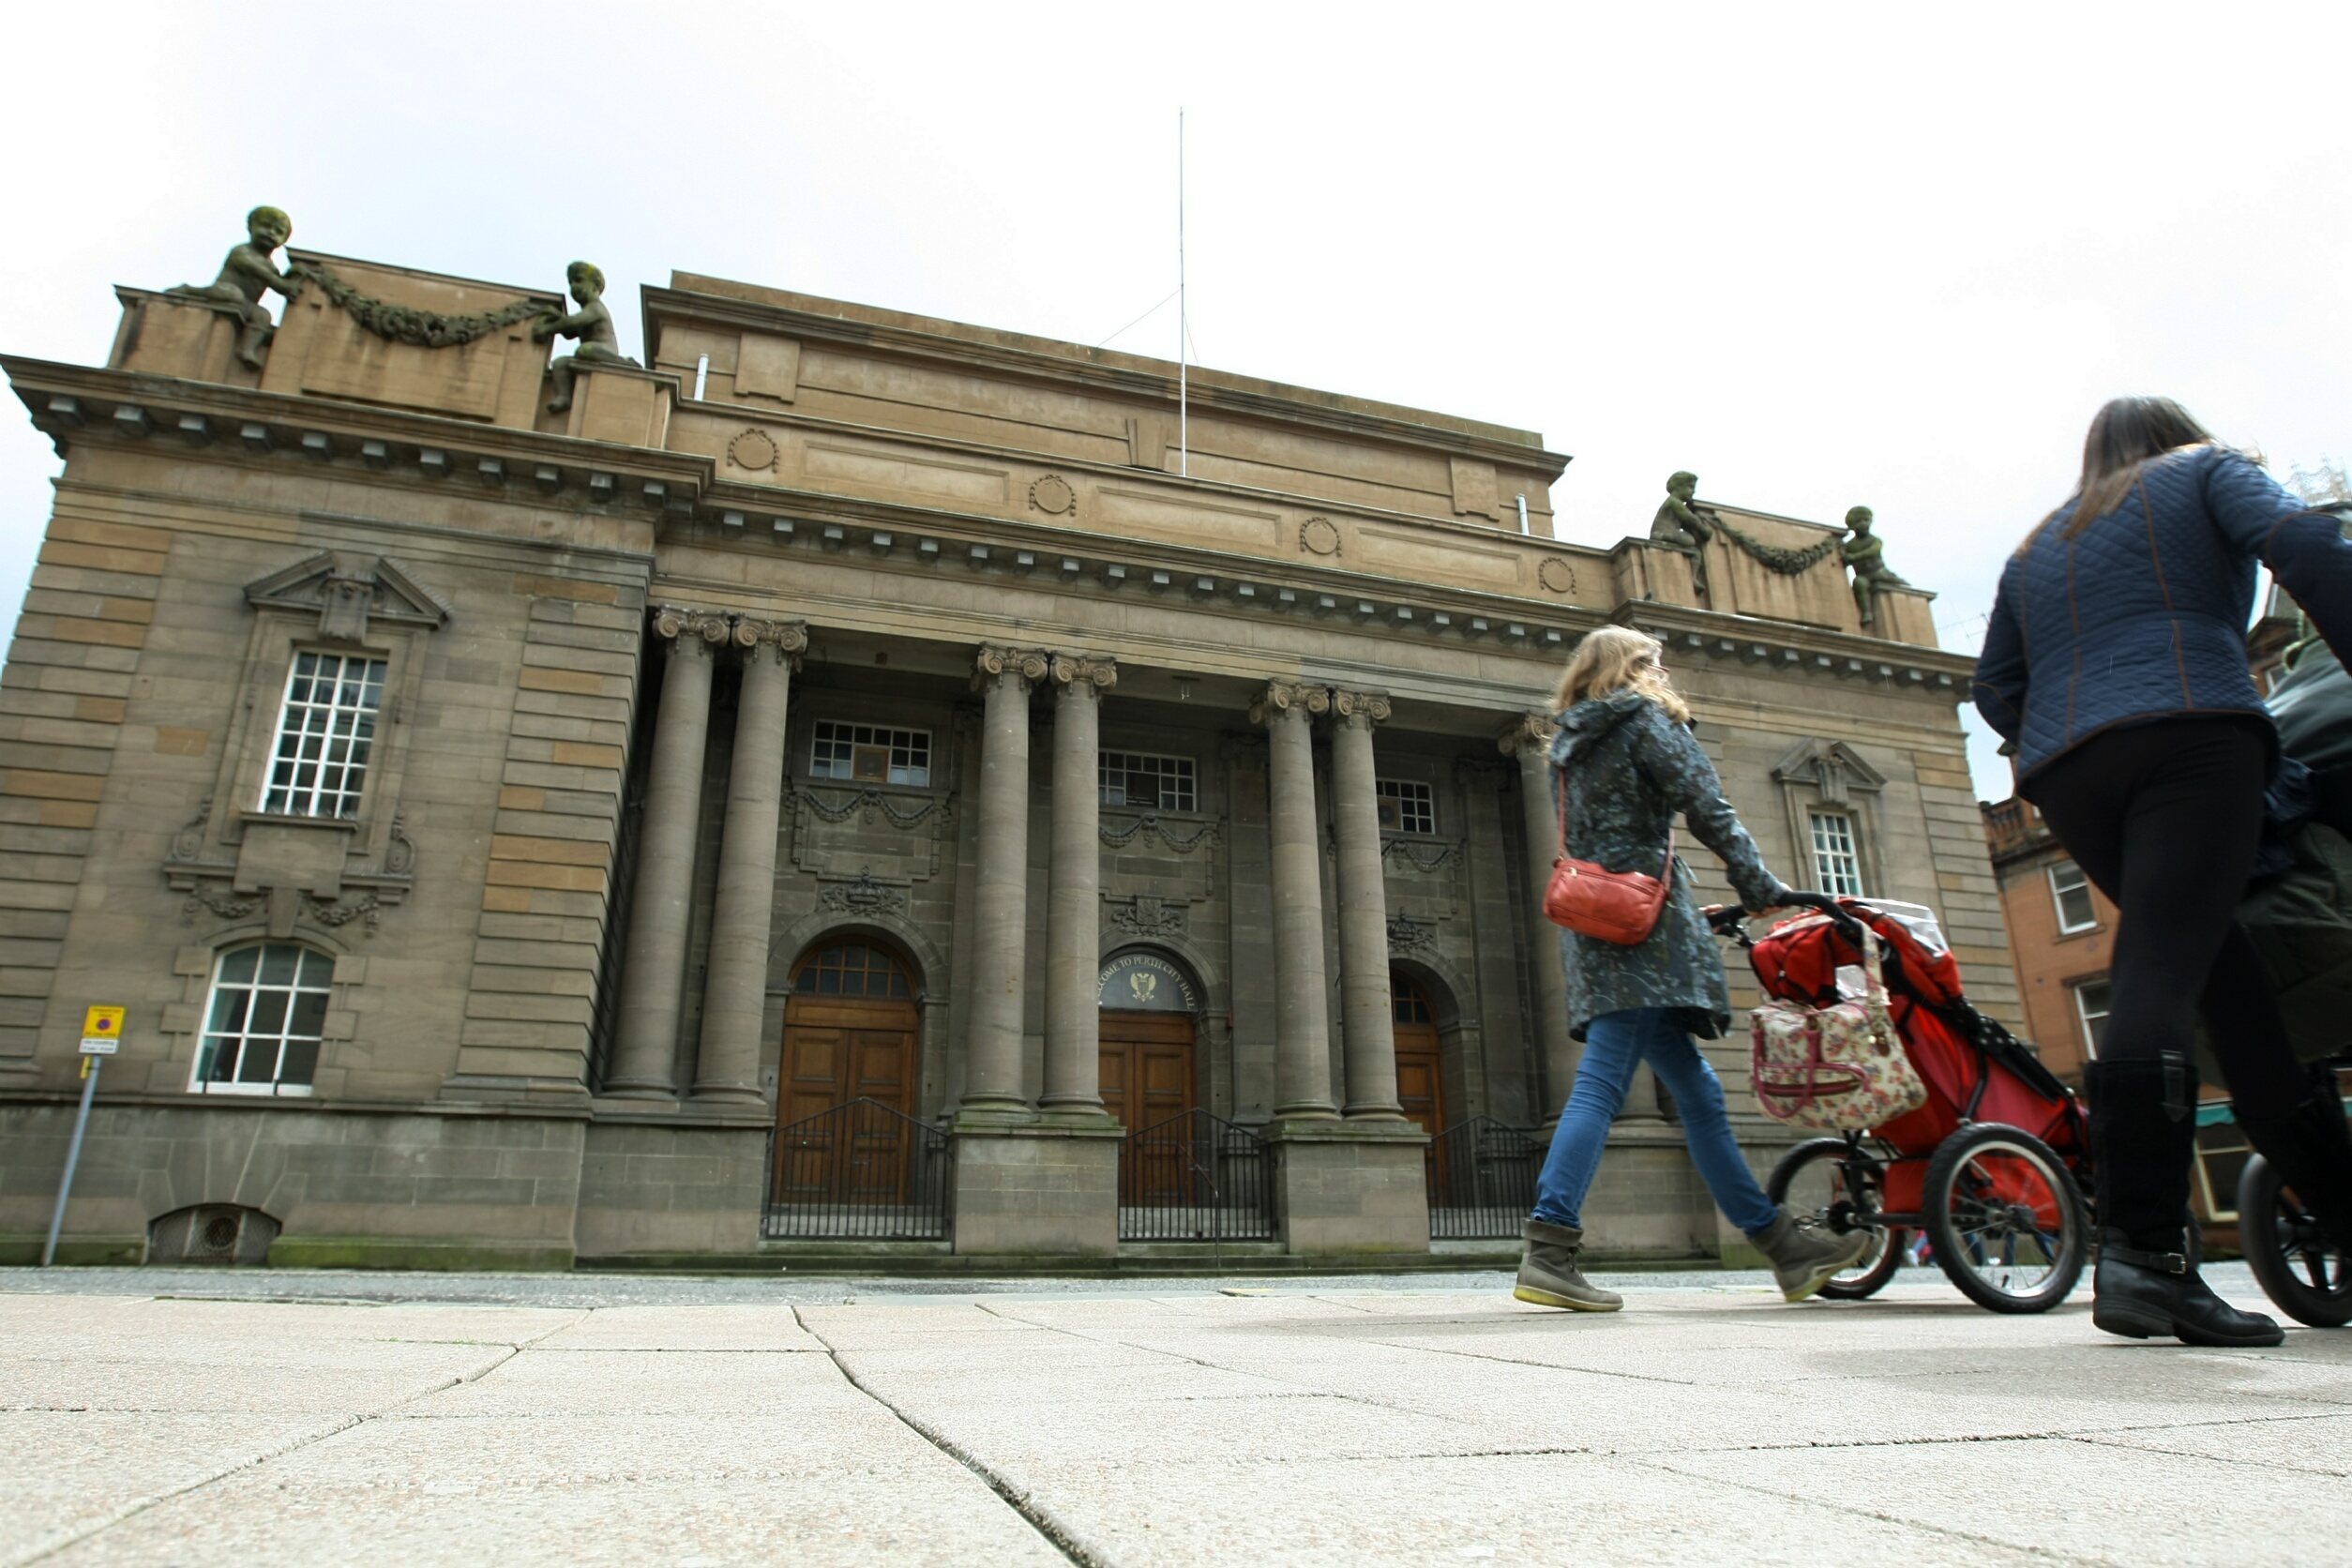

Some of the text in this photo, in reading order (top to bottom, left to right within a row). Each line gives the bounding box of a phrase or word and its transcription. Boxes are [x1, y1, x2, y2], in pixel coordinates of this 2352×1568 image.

[1097, 957, 1196, 1009] LCOME TO PERTH CITY HALL
